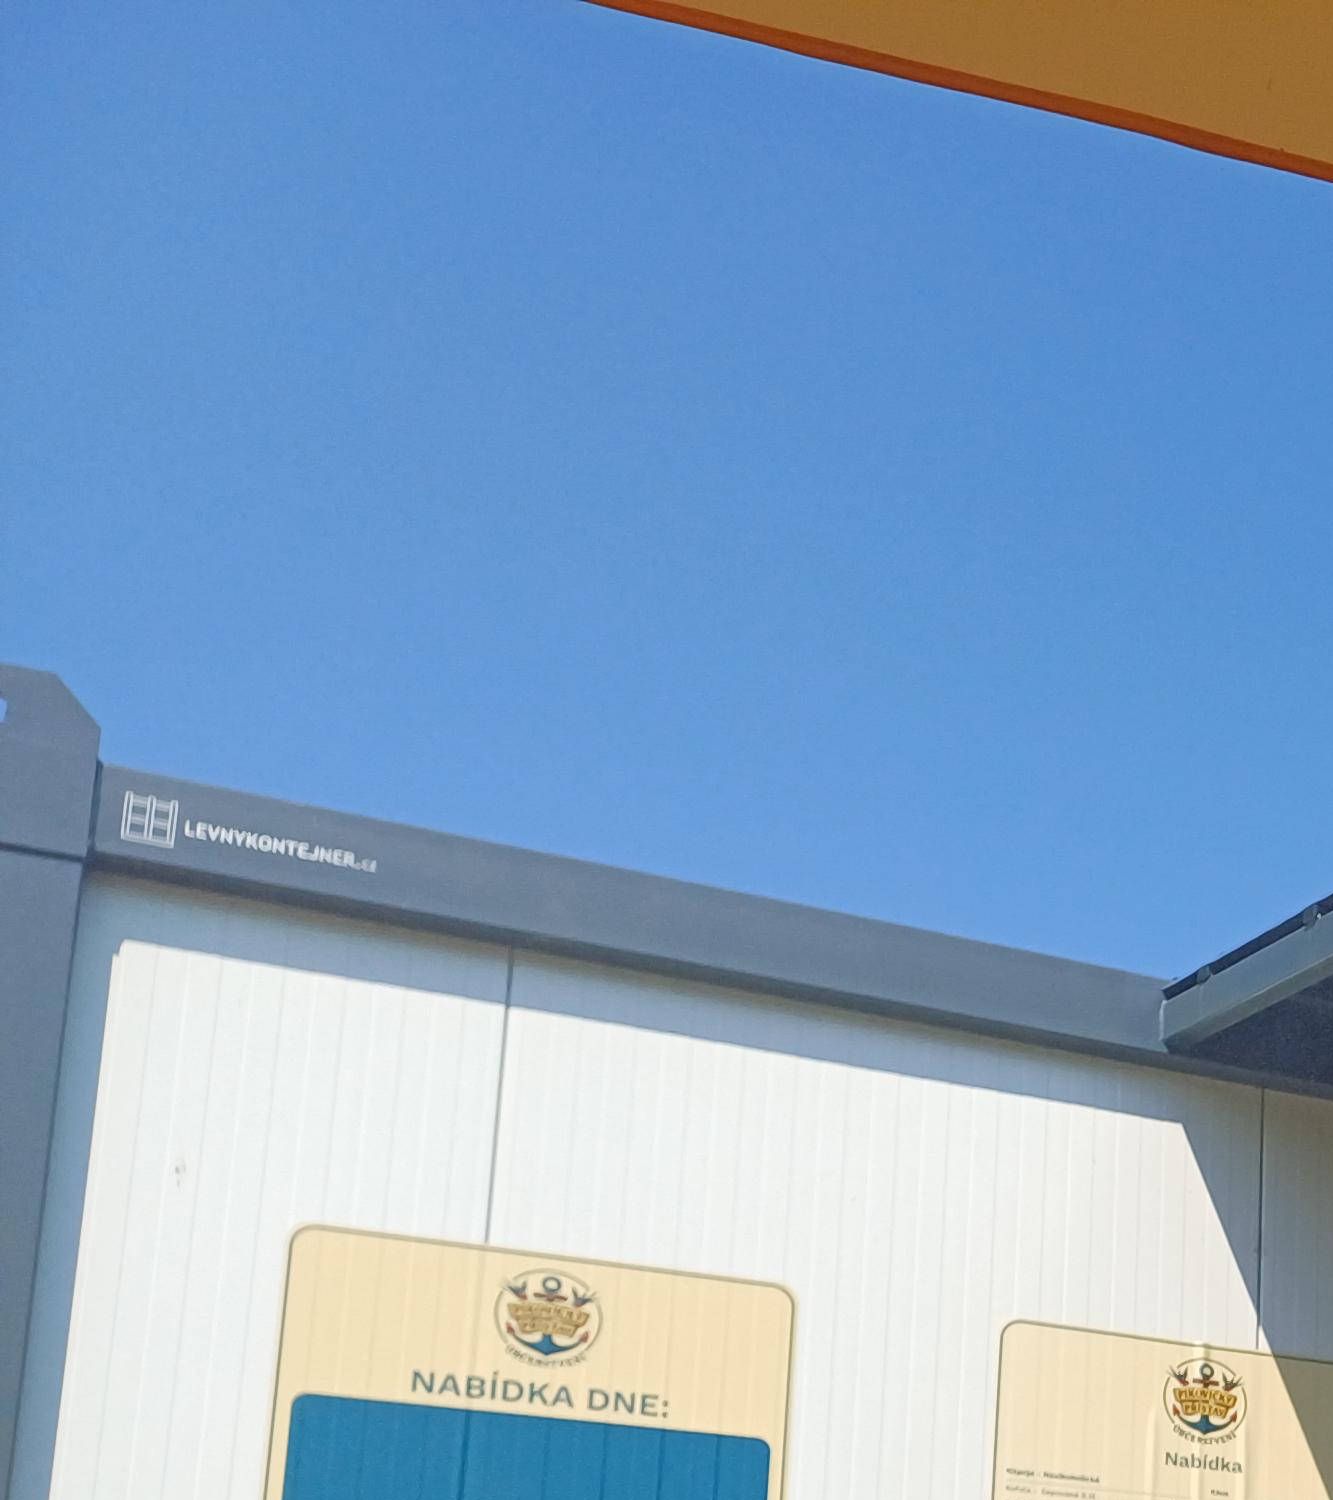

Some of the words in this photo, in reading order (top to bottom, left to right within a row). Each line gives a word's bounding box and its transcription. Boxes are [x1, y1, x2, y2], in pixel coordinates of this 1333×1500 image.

[411, 1370, 573, 1408] NABÍDKA
[588, 1388, 669, 1419] DNE:
[1164, 1451, 1243, 1474] Nabídka
